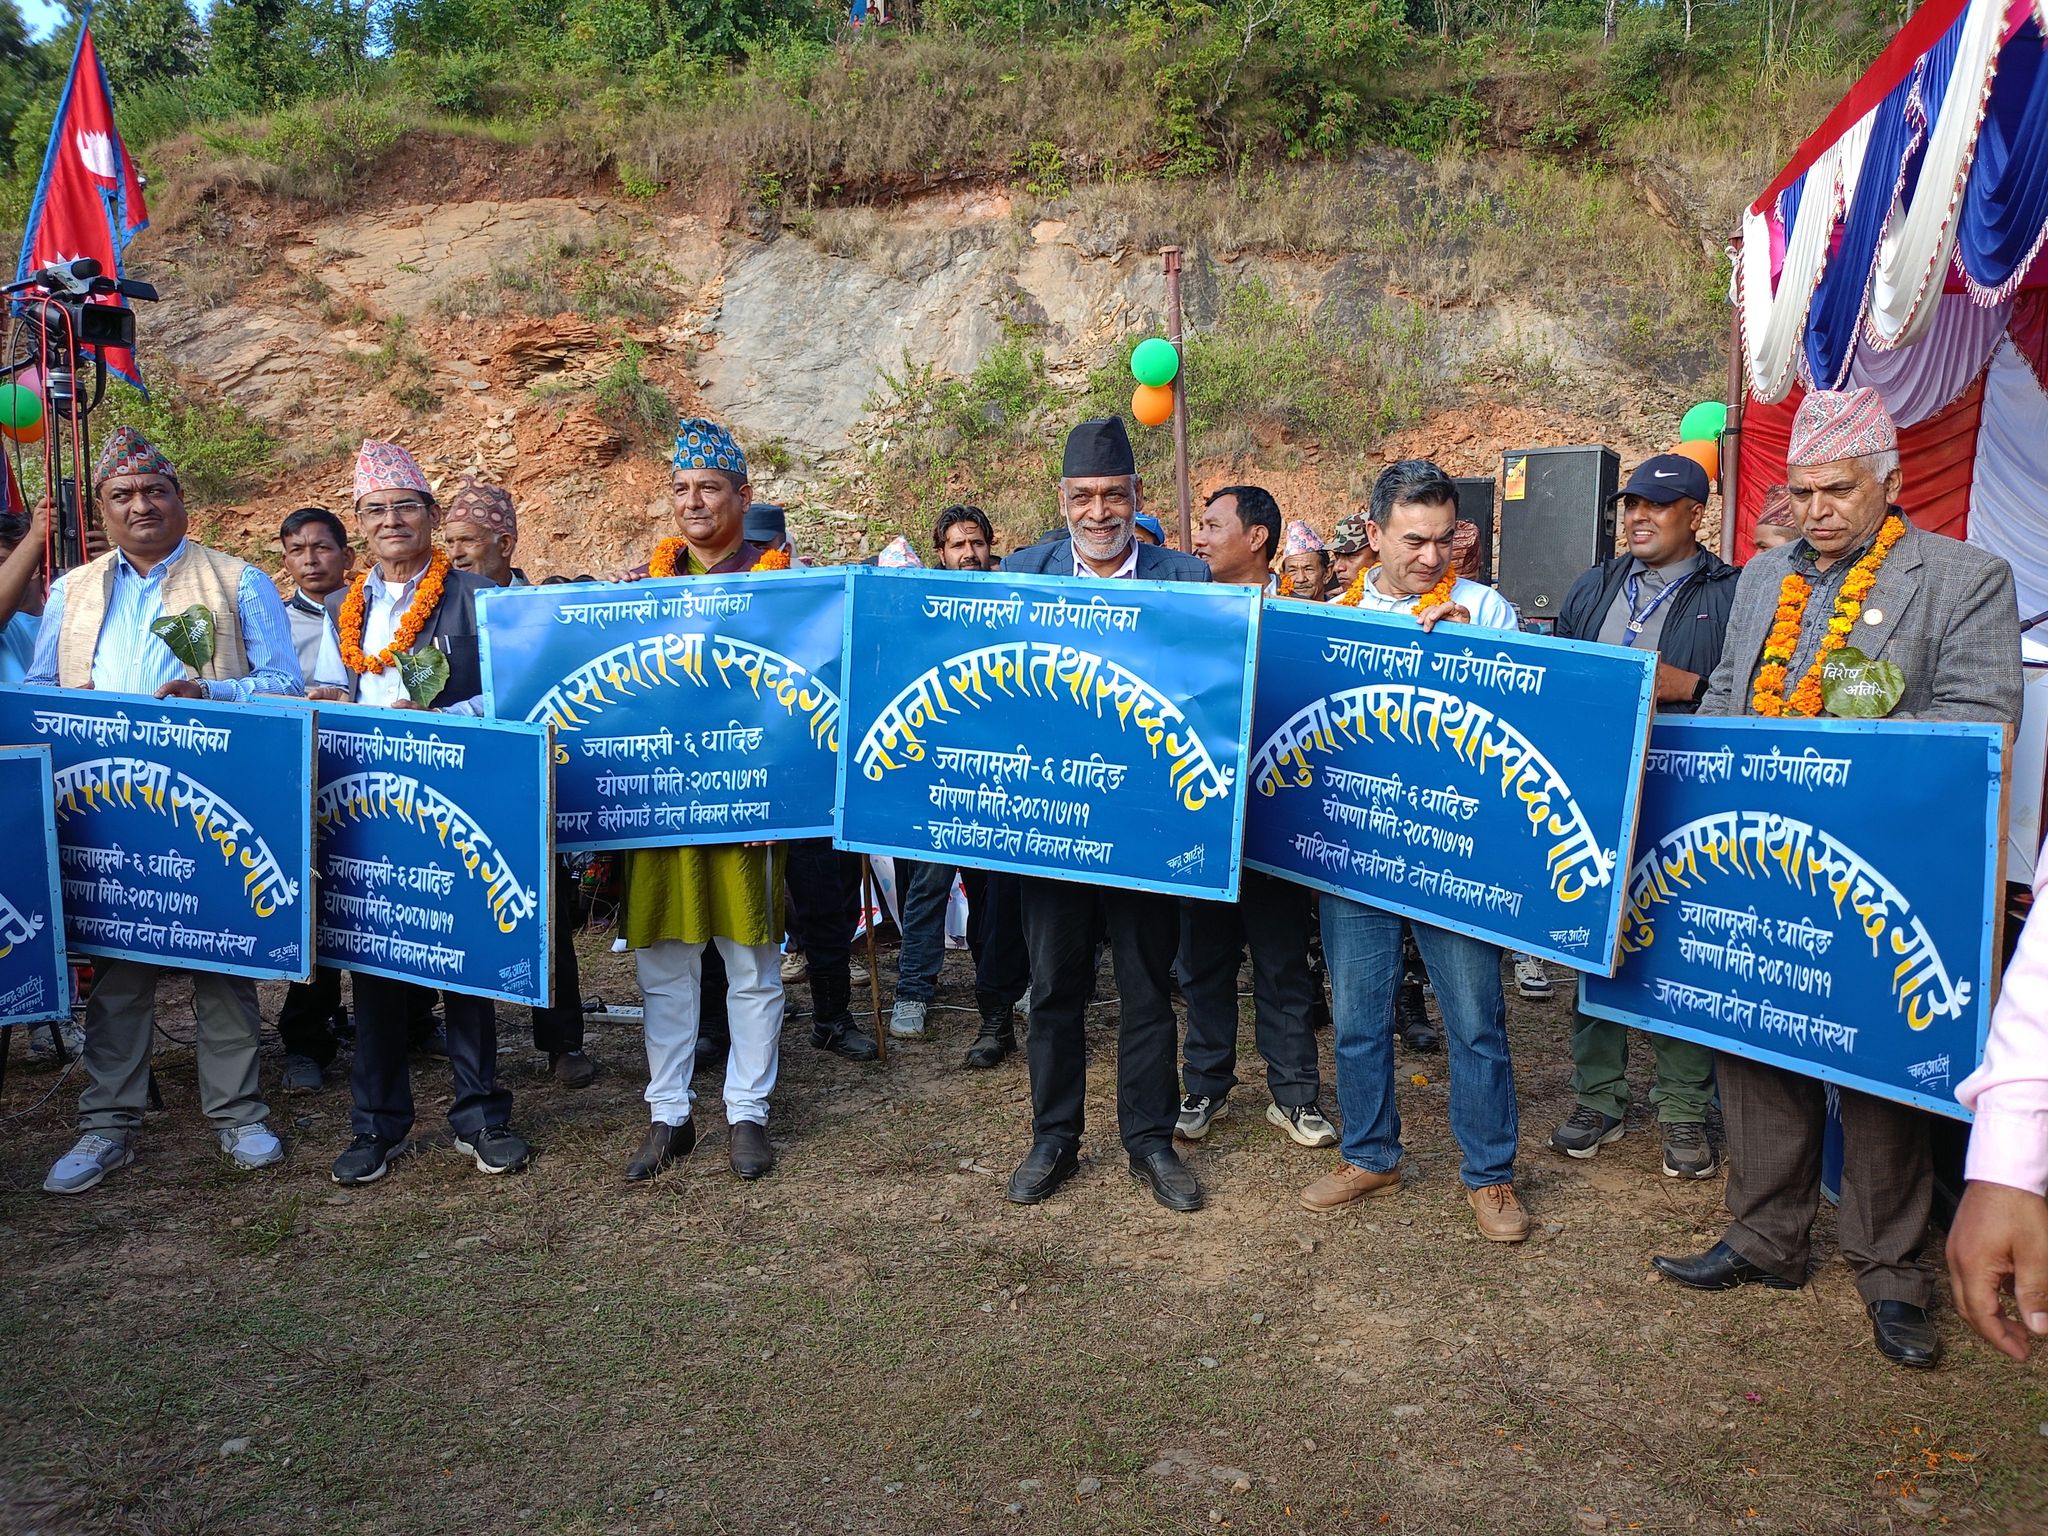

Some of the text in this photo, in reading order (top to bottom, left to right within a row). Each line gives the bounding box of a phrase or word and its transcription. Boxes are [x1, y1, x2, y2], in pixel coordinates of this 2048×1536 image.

[662, 587, 753, 622] गाउँपालिका
[1029, 595, 1141, 636] गाउँपालिका
[561, 641, 652, 714] सफा
[638, 633, 708, 687] तथा
[712, 634, 805, 716] स्वच्छ
[1430, 647, 1546, 695] गाउँपालिका
[1822, 663, 1862, 681] विशेष
[133, 715, 231, 756] गाउँपालिका
[854, 641, 1235, 810] नमुना सफा तथा स्वच्छ गाउँ
[384, 730, 465, 771] गाउँपालिका
[1741, 745, 1851, 792] गाउँपालिका
[596, 769, 649, 797] घोषणा
[929, 778, 975, 814] घोषणा
[1251, 684, 1617, 903] नमुना सफा तथा स्वच्छ गाउँ
[598, 802, 650, 832] बेसीगाउँ
[655, 802, 687, 830] टोल
[690, 800, 729, 826] विकास
[730, 799, 770, 824] संस्था
[1322, 794, 1367, 830] घोषणा
[111, 757, 171, 816] तथा
[170, 771, 253, 866] स्वच्छ
[242, 836, 299, 918] गाउँ
[365, 771, 418, 825] तथा
[416, 785, 491, 878] स्वच्छ
[481, 849, 537, 932] गाउँ
[993, 823, 1023, 856] टोल
[1026, 827, 1072, 860] विकास
[1072, 836, 1113, 864] संस्था
[324, 884, 365, 920] घोषणा
[1408, 861, 1439, 896] टोल
[1440, 869, 1485, 908] विकास
[1485, 882, 1523, 918] संस्था
[137, 917, 168, 949] टोल
[170, 921, 216, 953] विकास
[216, 928, 257, 957] संस्था
[1660, 811, 1739, 889] सफा
[1738, 811, 1814, 889] तथा
[1807, 829, 1910, 957] स्वच्छ
[1890, 915, 1971, 1031] गाउँ
[390, 930, 428, 971] विकास
[428, 942, 465, 975] संस्था
[1679, 931, 1724, 970] घोषणा
[1726, 939, 1755, 982] मिति
[1722, 989, 1757, 1033] टोल
[1760, 999, 1808, 1047] विकास
[1810, 1014, 1857, 1054] संस्था
